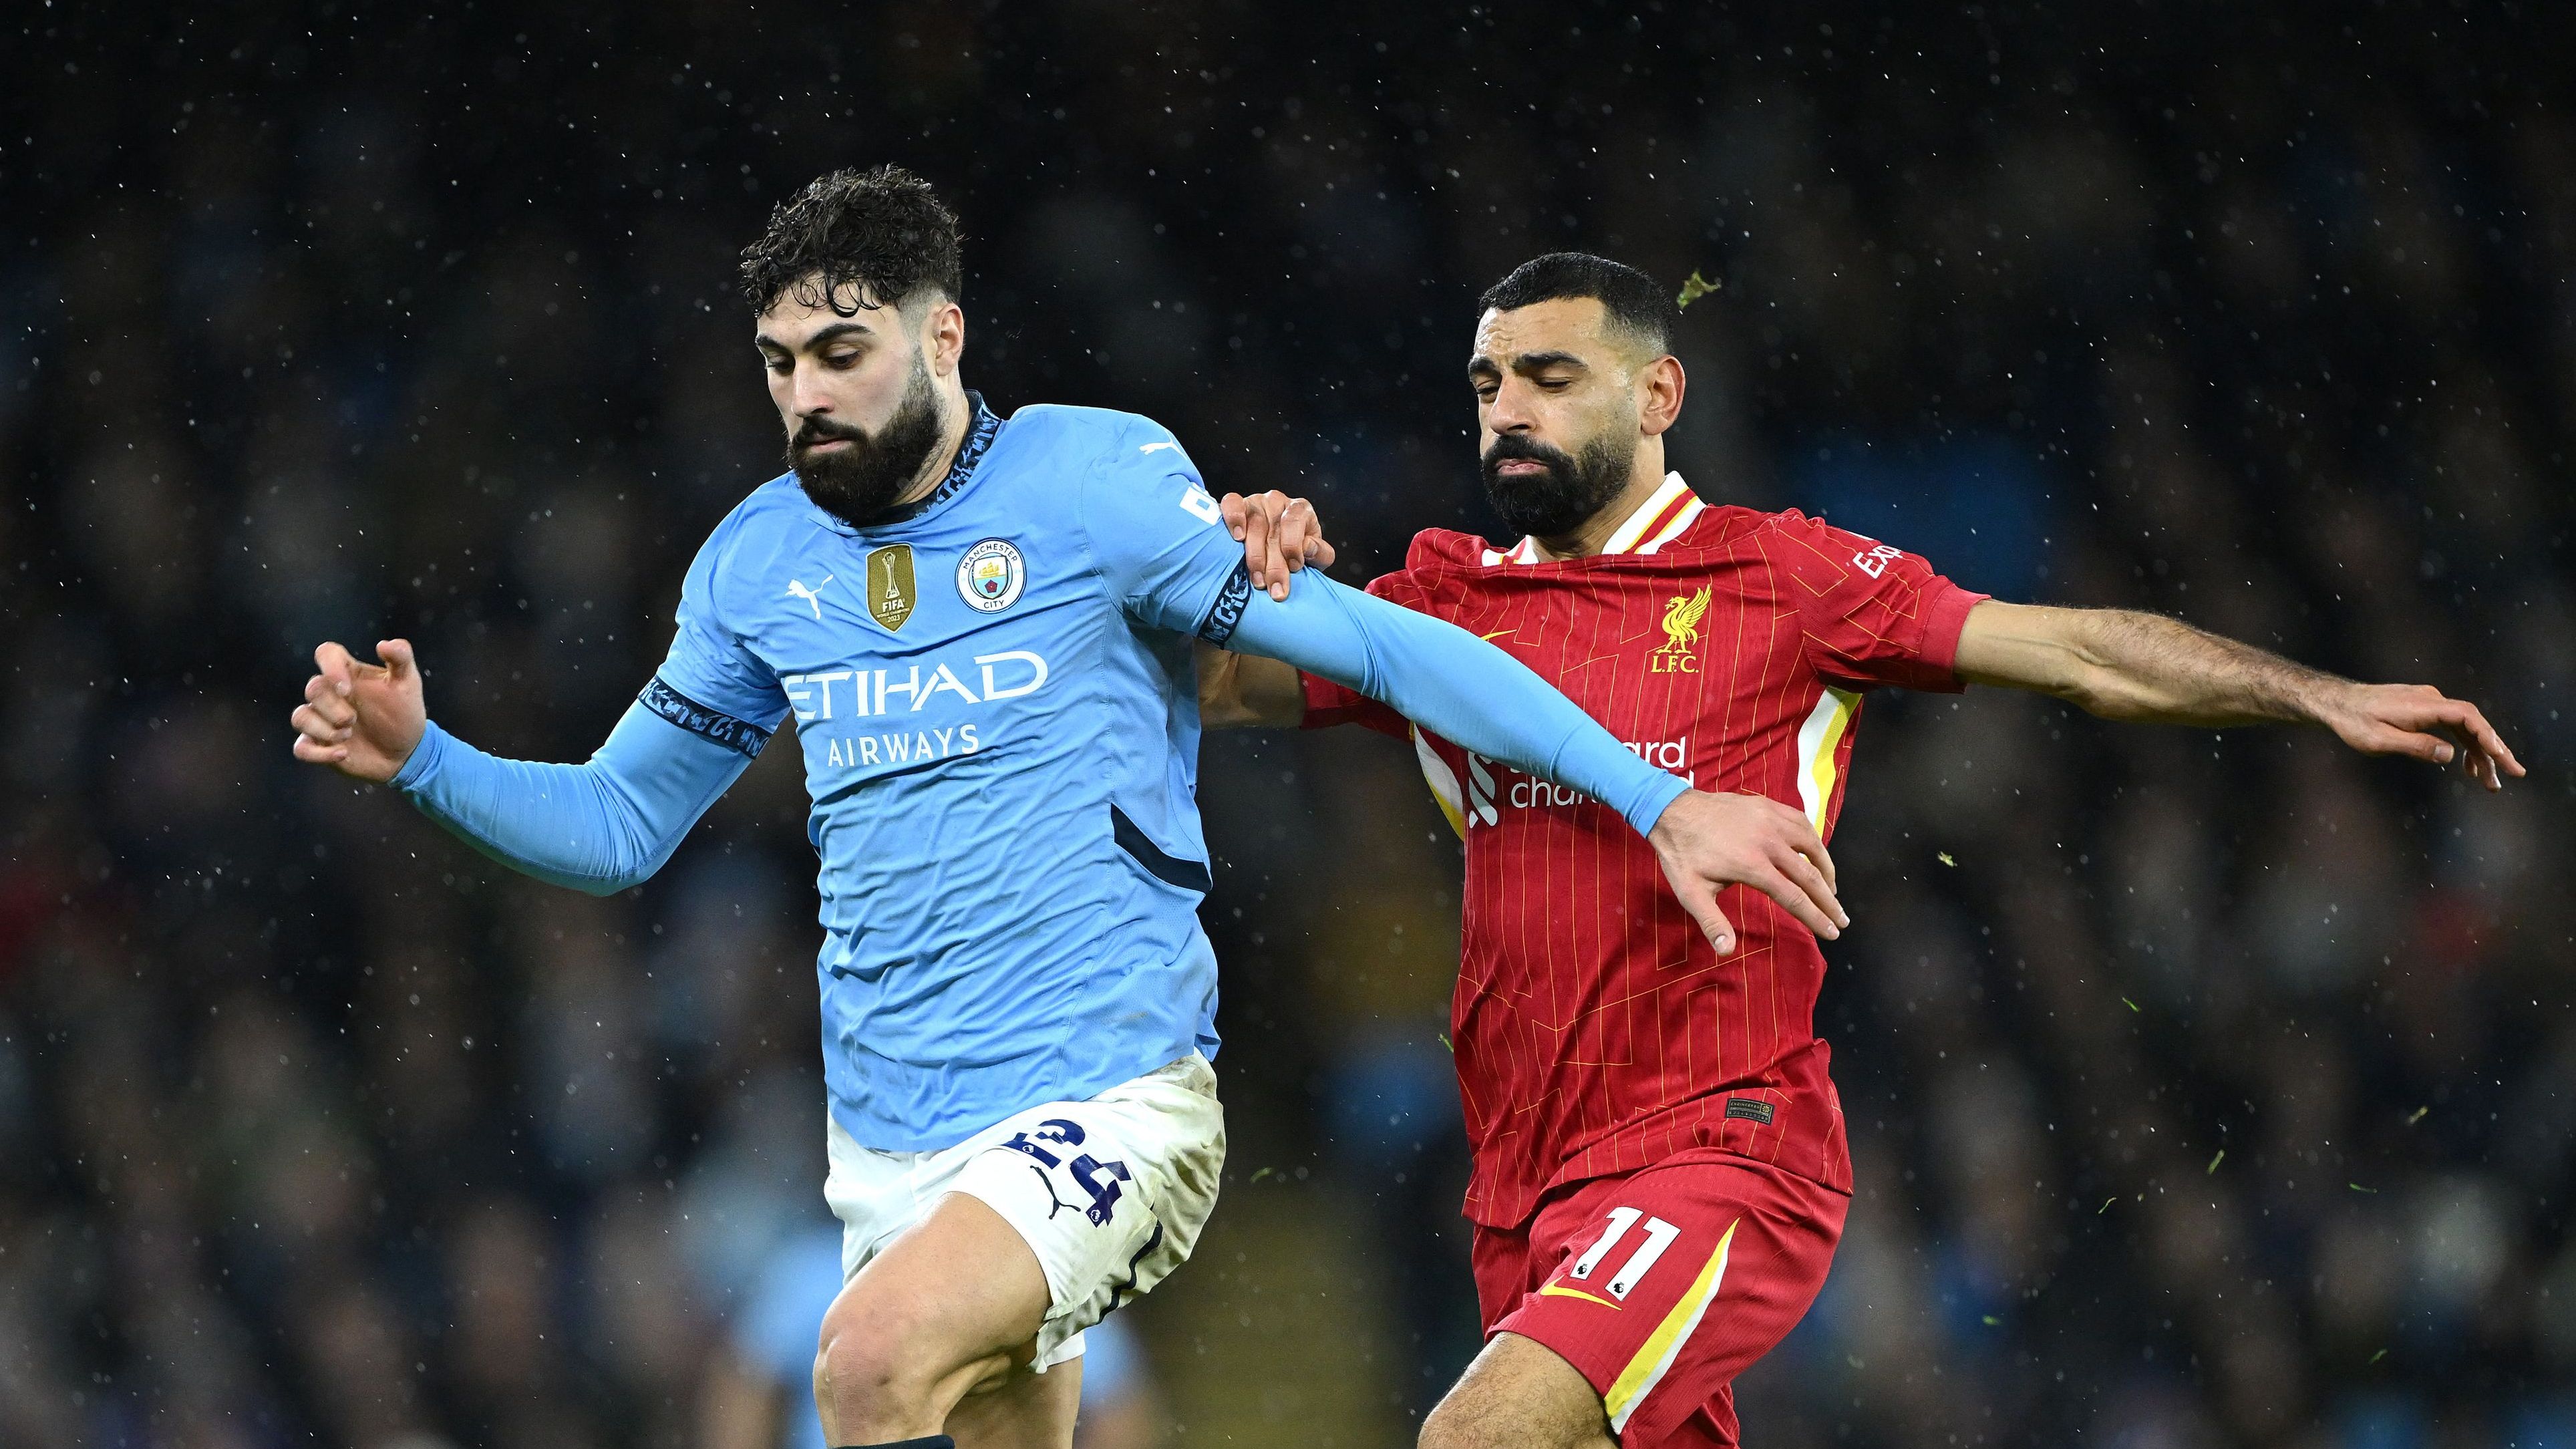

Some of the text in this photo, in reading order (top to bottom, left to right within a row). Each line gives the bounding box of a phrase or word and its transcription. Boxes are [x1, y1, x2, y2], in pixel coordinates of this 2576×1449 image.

[963, 543, 1018, 570] MANCHESTER
[1852, 545, 1903, 579] Exp
[882, 599, 905, 613] FIFA
[887, 614, 901, 623] 2023
[983, 600, 1004, 609] CITY
[1651, 655, 1700, 673] L.F.C.
[780, 650, 1049, 720] ETIHAD
[827, 723, 980, 768] AIRWAYS
[1000, 1118, 1132, 1229] 24
[1569, 1206, 1682, 1302] 11
